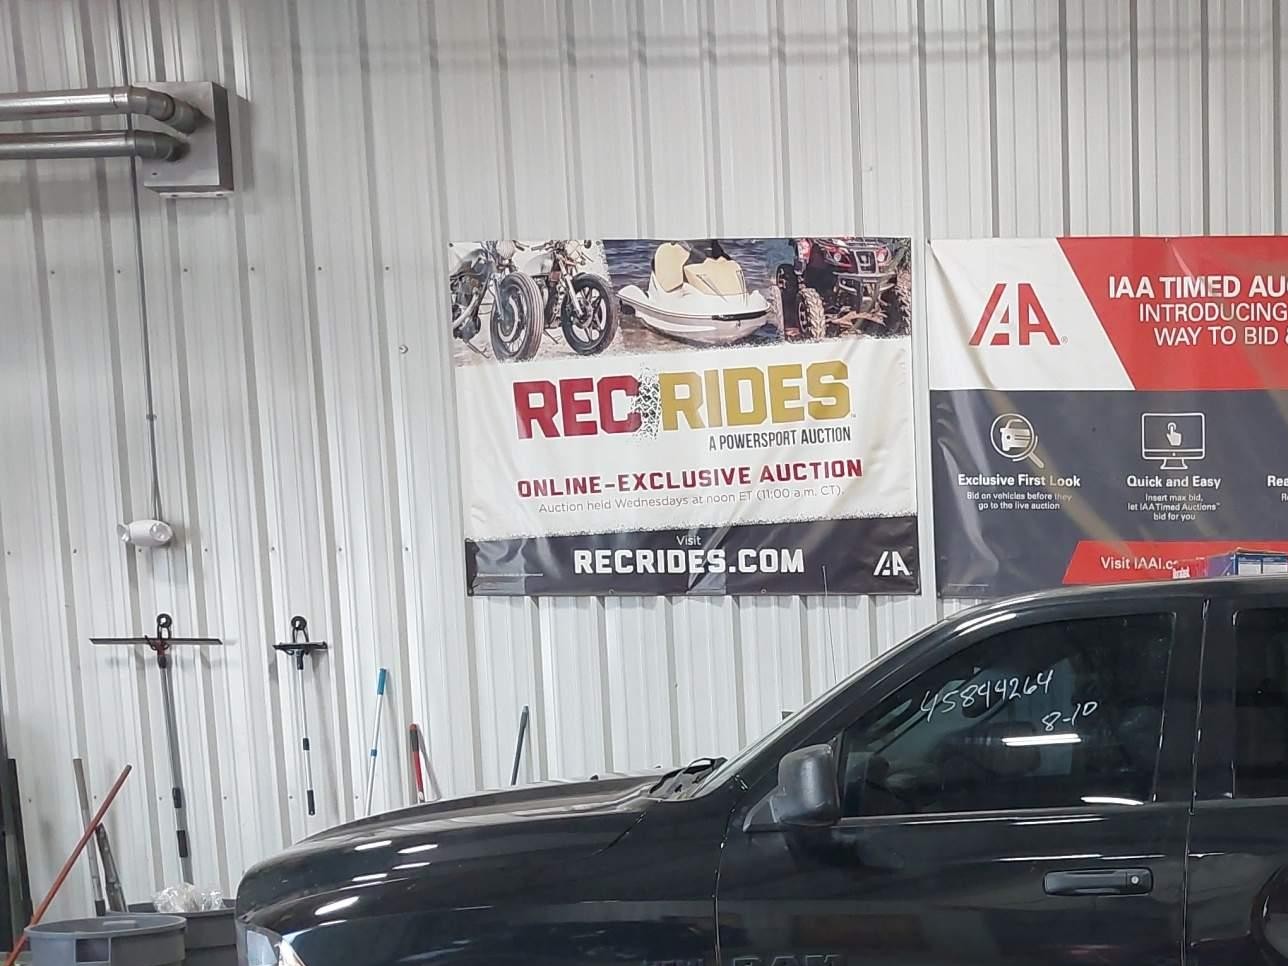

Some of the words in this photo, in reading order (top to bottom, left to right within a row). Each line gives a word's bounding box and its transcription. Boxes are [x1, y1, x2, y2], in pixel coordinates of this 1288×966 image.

[1109, 275, 1154, 298] IAA
[1159, 275, 1241, 298] TIMED
[1139, 302, 1288, 322] INTRODUCING
[1154, 326, 1202, 346] WAY
[1208, 326, 1237, 345] TO
[1244, 326, 1279, 345] BID
[658, 360, 851, 431] RIDES
[709, 435, 717, 451] A
[719, 430, 797, 450] POWERSPORT
[801, 426, 851, 445] AUCTION
[517, 467, 751, 498] ONLINE-EXCLUSIVE
[760, 459, 863, 483] AUCTION
[958, 474, 1015, 486] Exclusive
[1018, 474, 1046, 486] First
[1049, 475, 1081, 487] Look
[1127, 476, 1162, 487] Quick
[1166, 476, 1189, 487] and
[1192, 476, 1222, 490] Easy
[539, 503, 583, 513] Auction
[587, 501, 612, 511] held
[614, 495, 688, 509] Wednesdays
[692, 496, 703, 505] at
[707, 493, 735, 503] noon
[739, 491, 753, 502] ET
[756, 488, 790, 501] (11:00
[967, 491, 980, 500] Bid
[993, 491, 1025, 500] vehicles
[1027, 492, 1052, 500] before
[1054, 493, 1072, 502] they
[1145, 493, 1167, 501] Insert
[978, 503, 989, 511] go
[990, 502, 998, 510] to
[1000, 501, 1013, 510] the
[1015, 501, 1029, 510] live
[1031, 502, 1060, 510] auction
[1127, 503, 1138, 511] let
[1140, 503, 1155, 511] IAA
[1155, 503, 1180, 511] Timed
[1153, 512, 1166, 520] bid
[1167, 512, 1179, 520] for
[1181, 513, 1196, 522] you
[676, 534, 702, 546] Visit
[574, 549, 805, 574] RECRIDES.COM
[1100, 557, 1130, 570] Visit
[1041, 701, 1098, 732] 8-10
